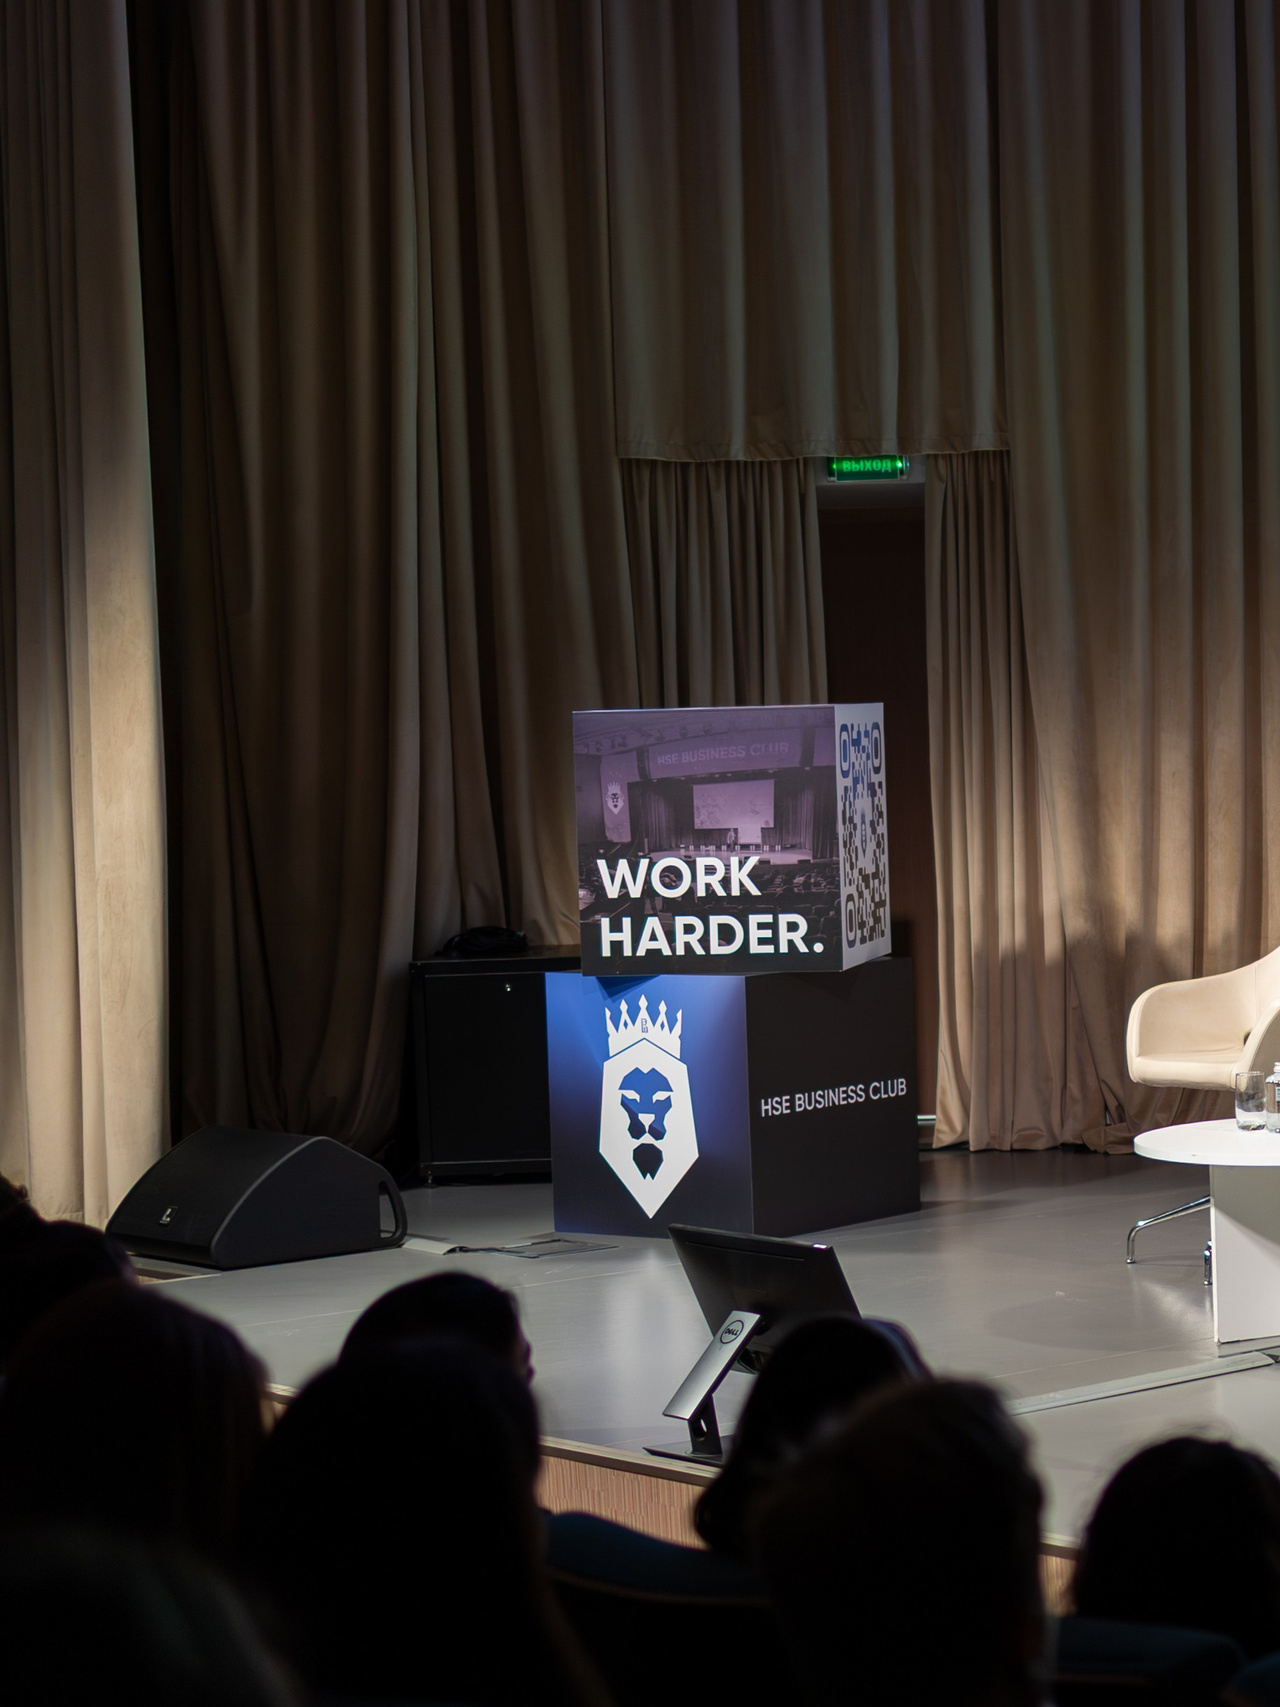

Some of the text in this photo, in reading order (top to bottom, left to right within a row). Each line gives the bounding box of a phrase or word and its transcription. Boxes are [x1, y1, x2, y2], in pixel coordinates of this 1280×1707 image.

[843, 459, 891, 472] ВЫХОД
[657, 742, 789, 765] HSE BUSINESS CLUB
[596, 856, 762, 899] WORK
[600, 913, 824, 957] HARDER.
[761, 1078, 907, 1118] HSE BUSINESS CLUB
